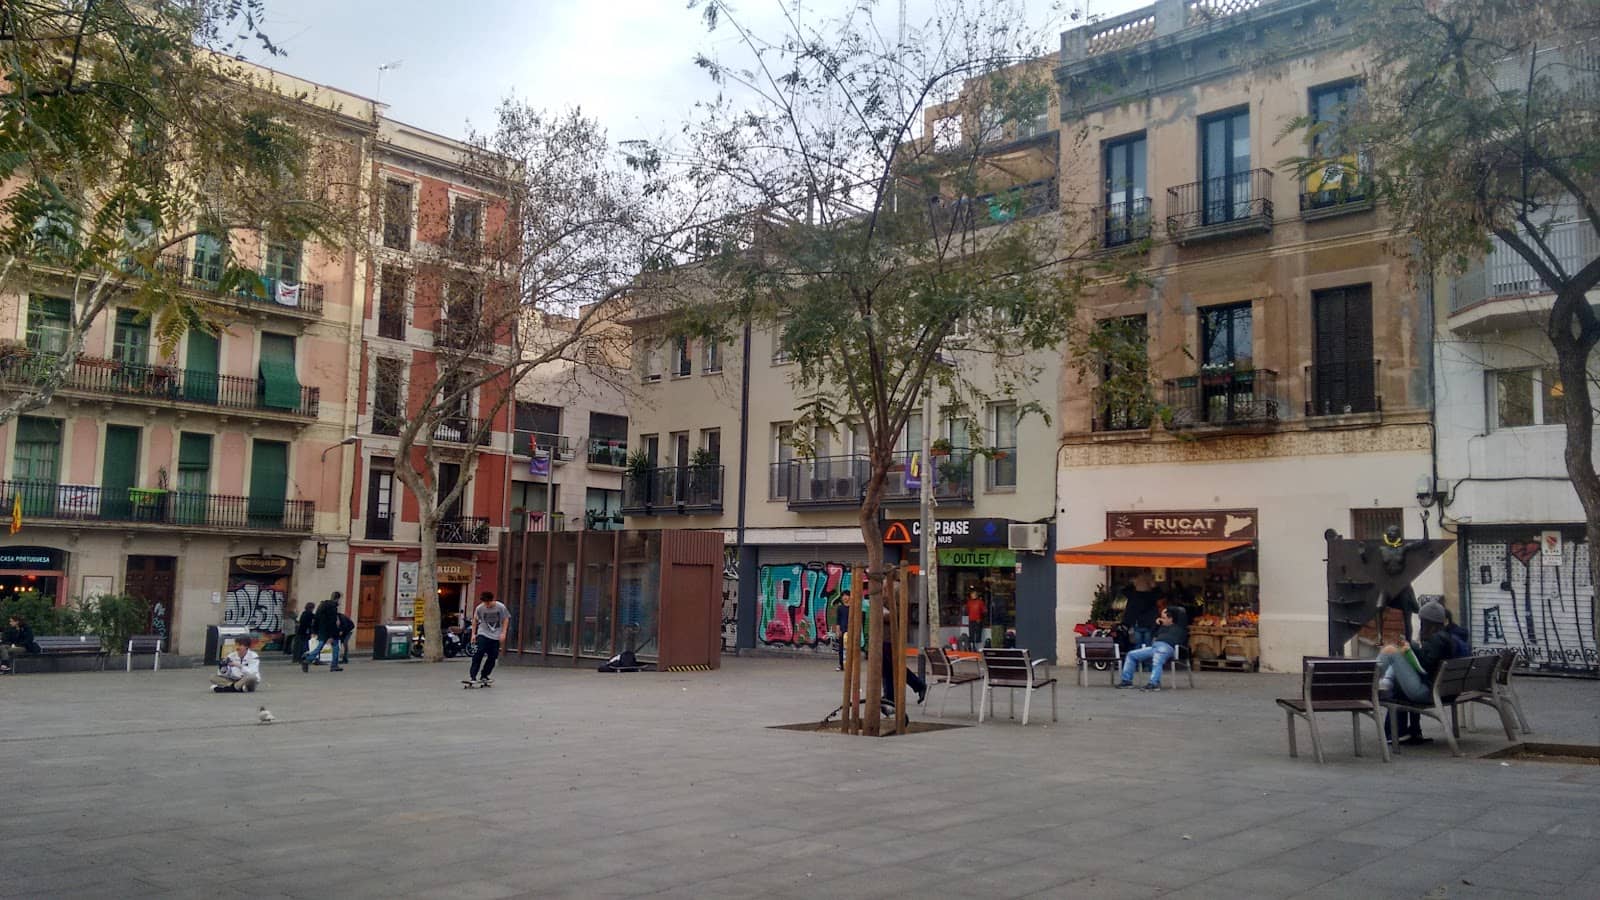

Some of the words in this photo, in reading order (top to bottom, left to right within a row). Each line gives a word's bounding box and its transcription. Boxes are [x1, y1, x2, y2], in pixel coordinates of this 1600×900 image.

[912, 521, 940, 535] CP
[942, 521, 969, 535] BASE
[1143, 518, 1216, 529] FRUCAT
[953, 553, 990, 565] OUTLET
